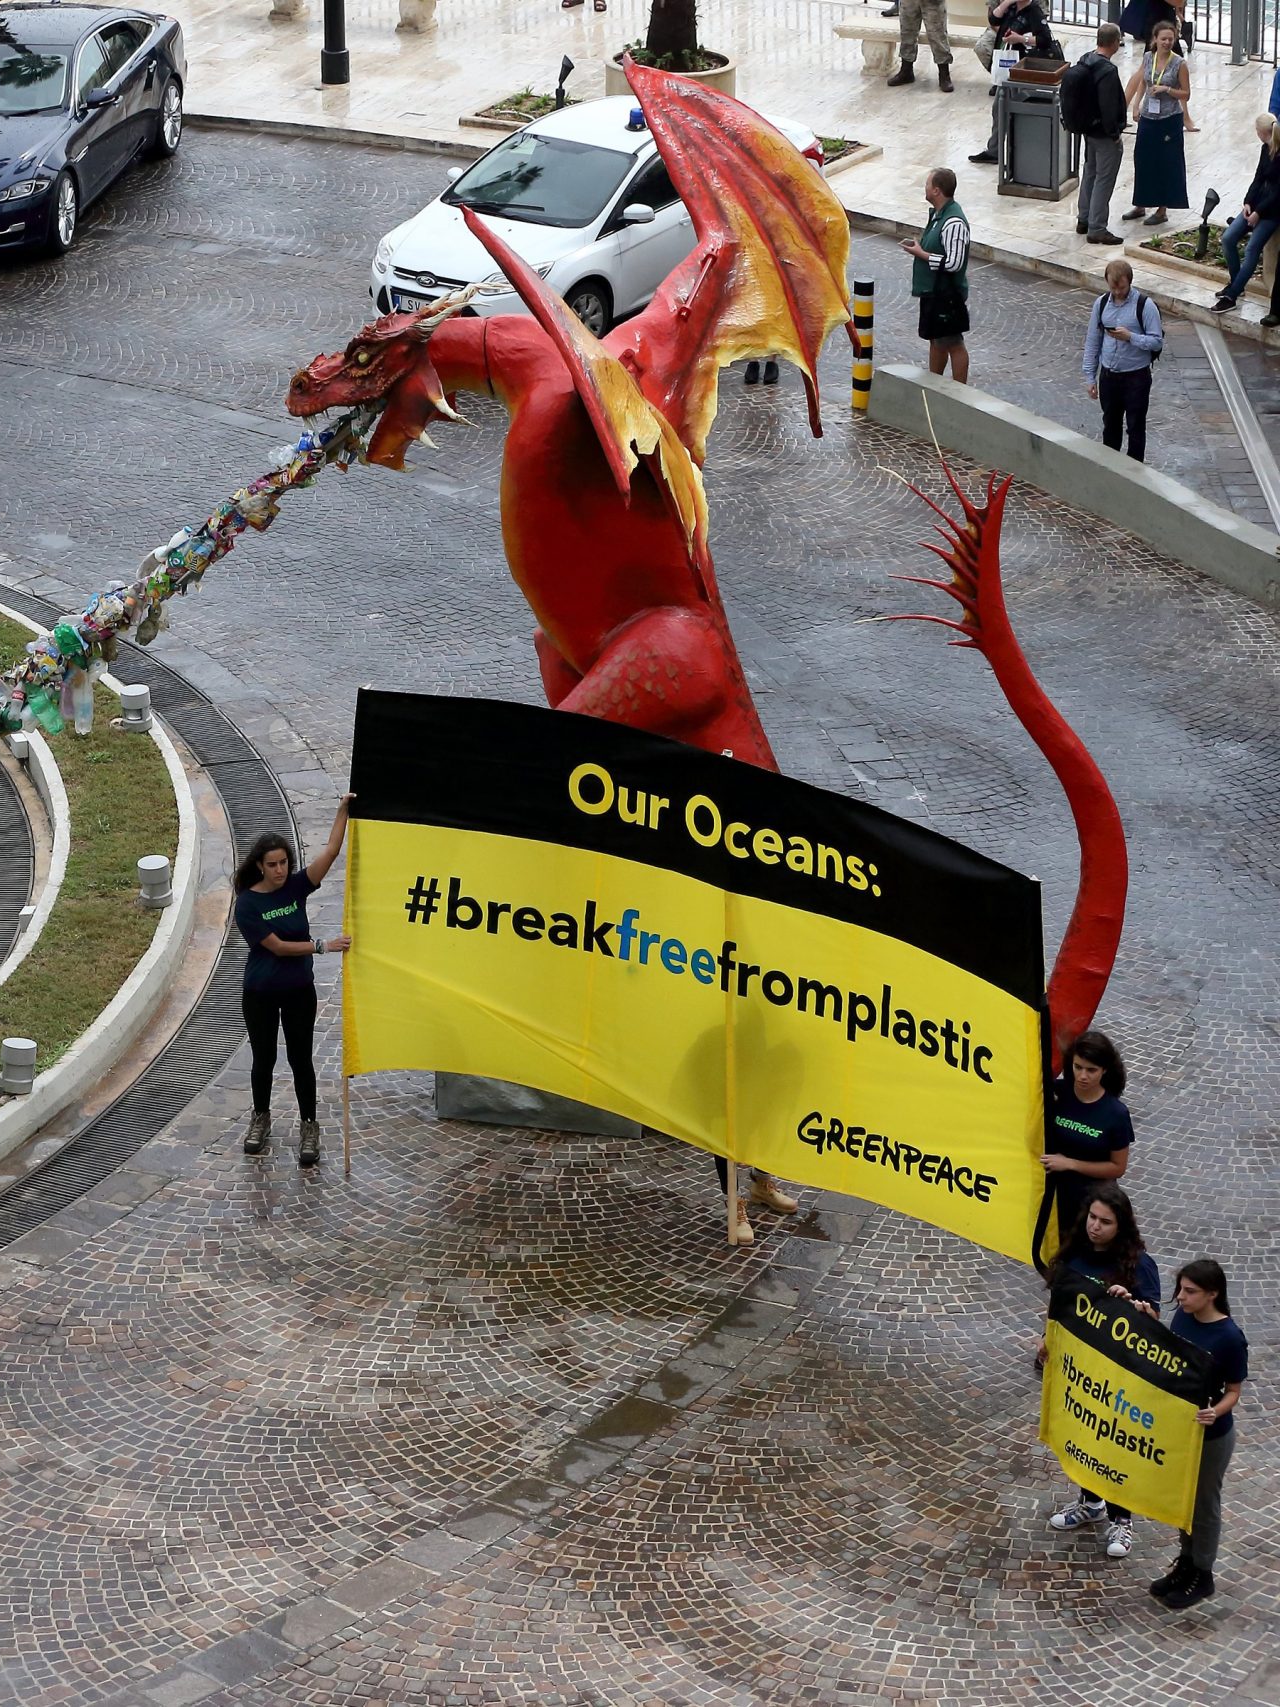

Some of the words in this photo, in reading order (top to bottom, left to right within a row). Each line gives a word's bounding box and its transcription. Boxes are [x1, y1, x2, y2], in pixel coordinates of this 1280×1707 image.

[568, 762, 670, 830] Our
[685, 794, 882, 897] Oceans:
[404, 875, 994, 1084] #breakfreefromplastic
[797, 1111, 999, 1203] GREENPEACE
[1055, 1115, 1103, 1138] REENPEACE
[1075, 1293, 1108, 1329] Our
[1111, 1317, 1188, 1377] Oceans:
[1064, 1440, 1129, 1485] GREENPEACE
